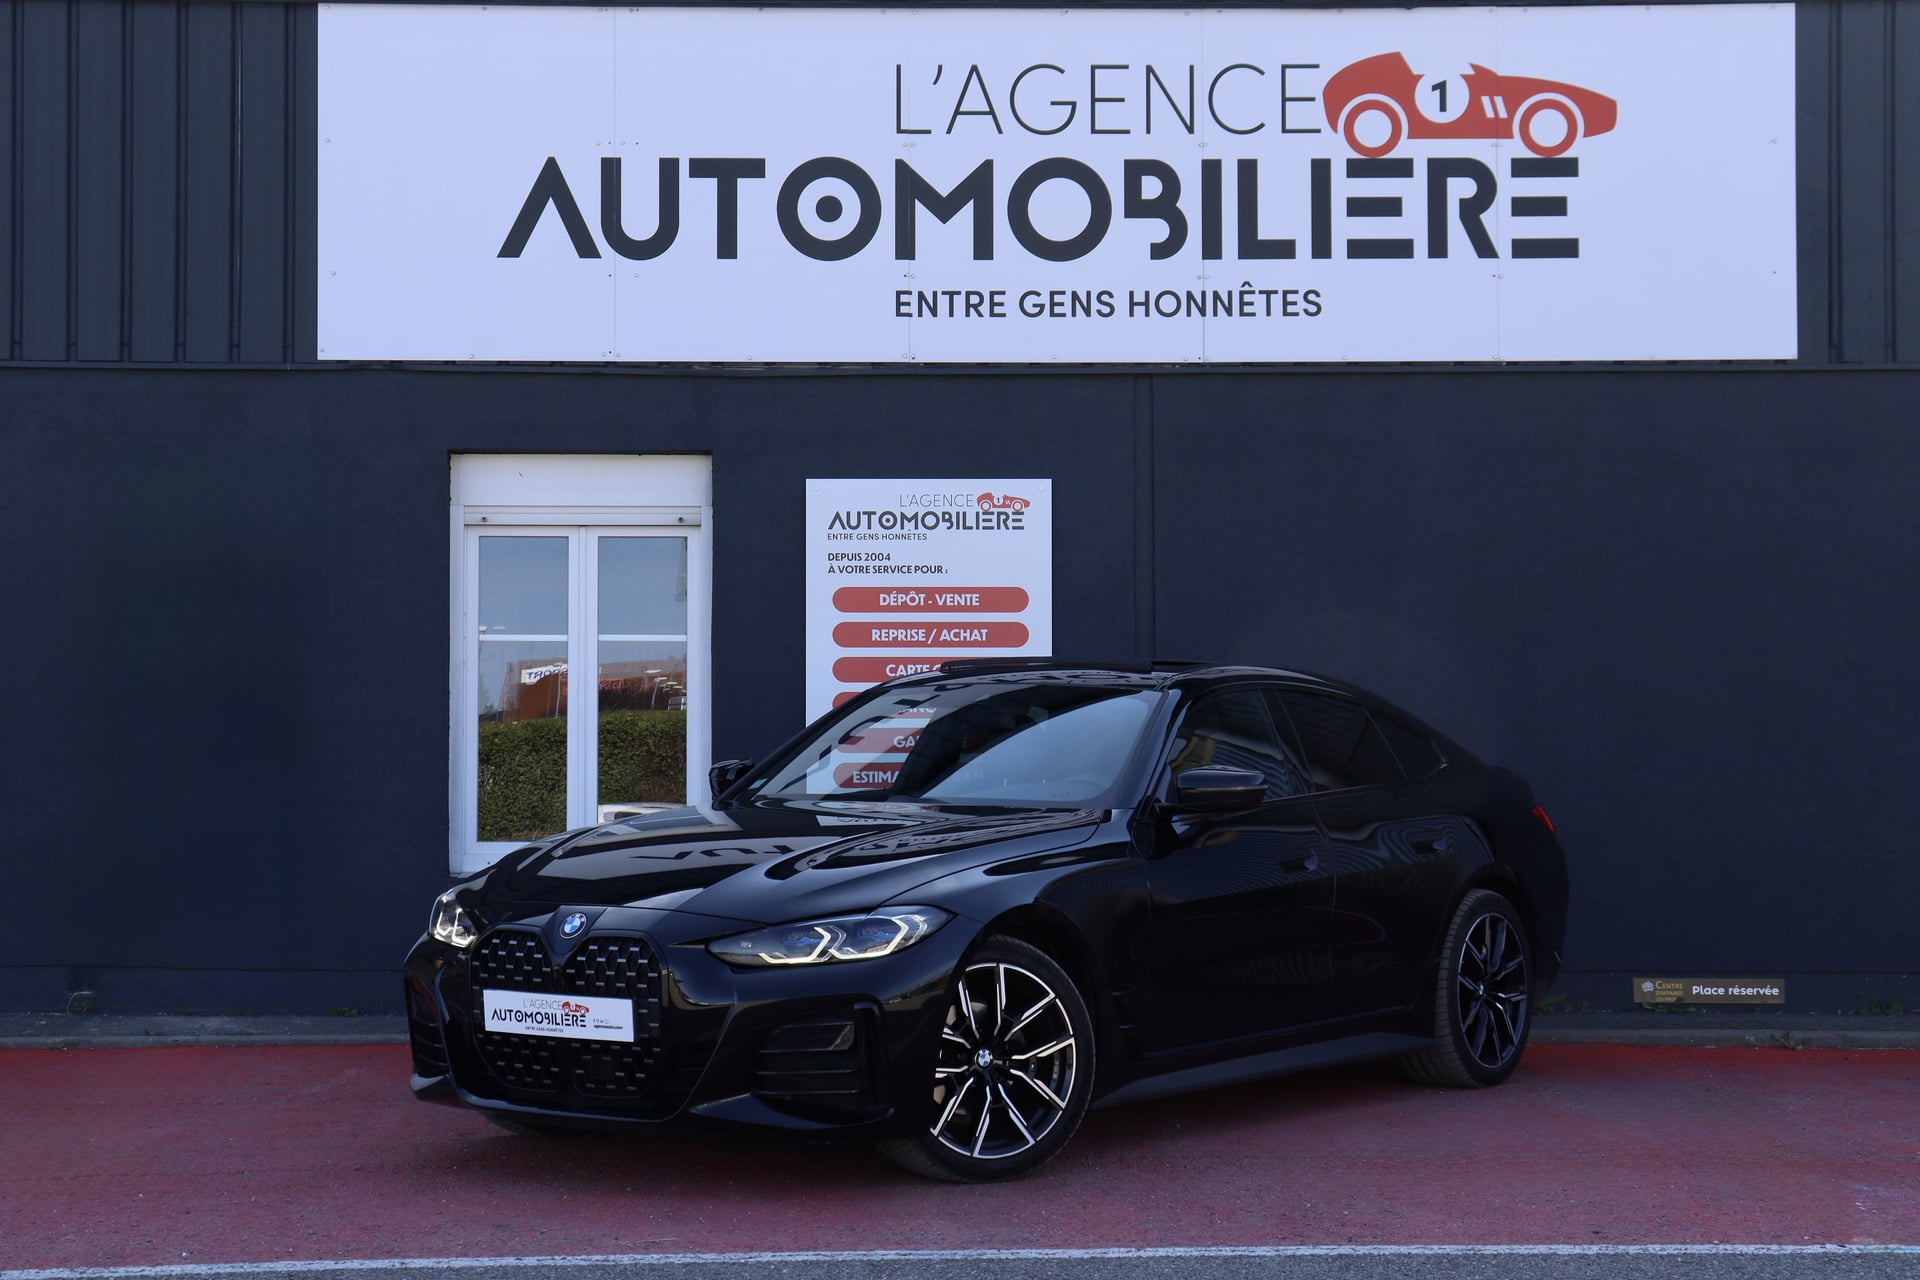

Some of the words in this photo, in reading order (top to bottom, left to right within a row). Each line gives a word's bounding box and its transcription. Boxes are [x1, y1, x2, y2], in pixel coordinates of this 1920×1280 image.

[896, 63, 1321, 136] L'AGENCE
[1431, 79, 1447, 113] 1
[497, 156, 1580, 262] AUTOMOBILIERE
[896, 289, 1006, 318] ENTRE
[1019, 289, 1116, 318] GENS
[1129, 281, 1322, 318] HONNÊTES
[900, 493, 974, 507] L'AGENCE
[828, 510, 1025, 531] AUTOMOBILIERE
[828, 533, 853, 541] ENTRE
[856, 533, 879, 541] GENS
[882, 529, 927, 541] HONNÊTES
[828, 552, 862, 562] DEPUIS
[864, 552, 891, 562] 2004
[828, 563, 836, 575] À
[838, 565, 870, 574] VOTRE
[873, 565, 912, 574] SERVICE
[914, 565, 943, 574] POUR
[879, 590, 925, 606] DÉPÔT
[935, 594, 980, 606] VENTE
[872, 629, 925, 641] REPRISE
[940, 629, 988, 641] ACHAT
[886, 664, 930, 677] CARTE
[1692, 985, 1725, 996] Place
[1729, 985, 1780, 996] réservée
[523, 998, 562, 1011] L'AGENCE
[491, 1008, 587, 1028] AUTOMOBILIERE
